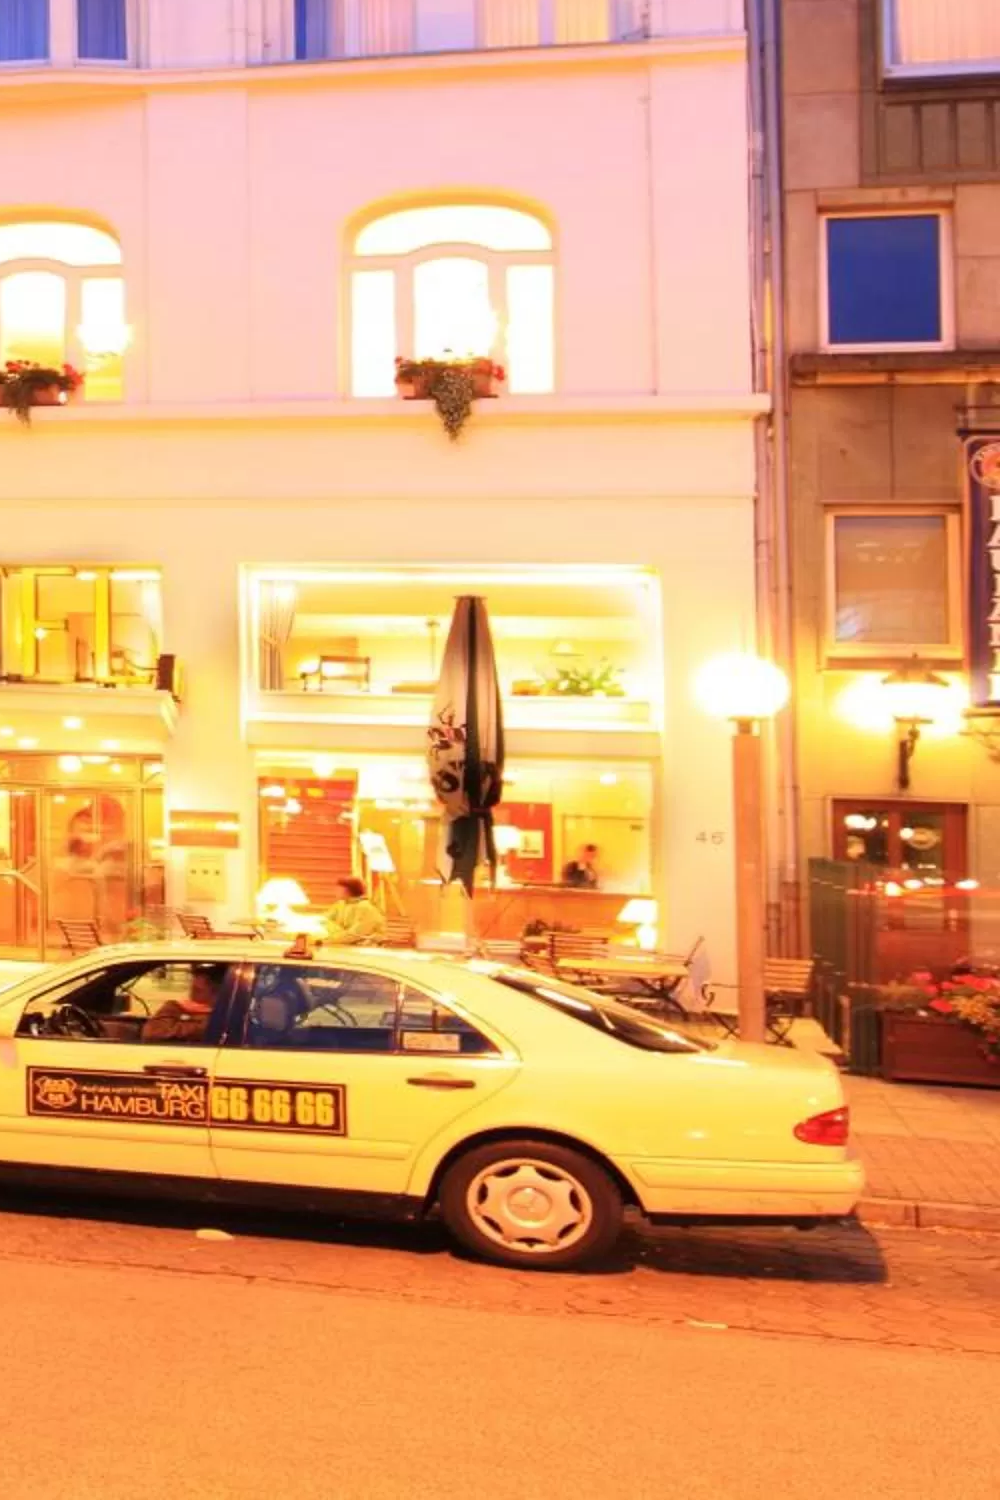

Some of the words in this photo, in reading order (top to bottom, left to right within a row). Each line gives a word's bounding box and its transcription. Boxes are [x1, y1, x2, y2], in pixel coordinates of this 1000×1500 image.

[157, 1082, 205, 1102] TAXI
[81, 1094, 205, 1119] HAMBURG
[211, 1086, 248, 1121] 66
[254, 1088, 291, 1124] 66
[297, 1091, 335, 1126] 66
